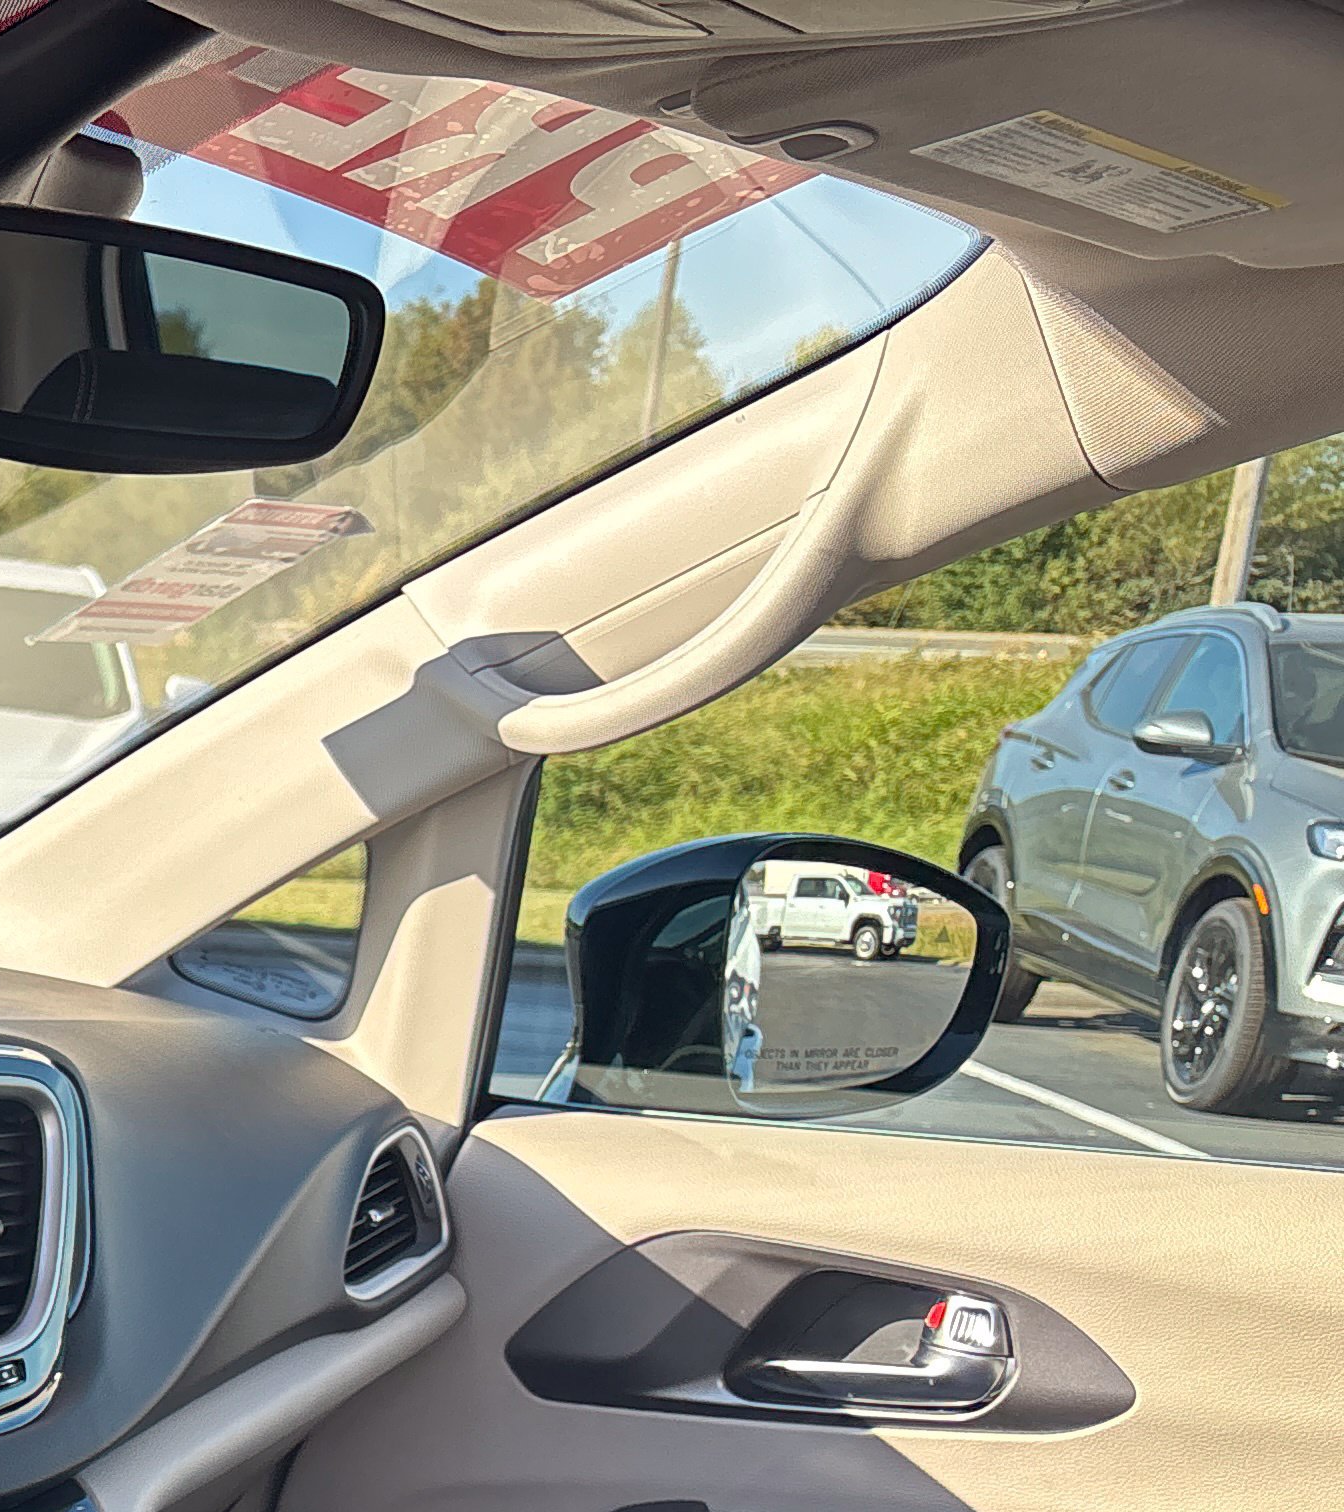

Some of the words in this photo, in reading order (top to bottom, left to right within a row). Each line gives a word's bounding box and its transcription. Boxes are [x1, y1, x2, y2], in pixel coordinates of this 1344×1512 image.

[790, 1047, 799, 1059] IN
[804, 1047, 840, 1059] MIRROR
[843, 1047, 861, 1059] ARE
[865, 1046, 900, 1058] CLOSER
[776, 1060, 801, 1072] THAN
[806, 1060, 829, 1071] THEY
[832, 1060, 871, 1071] APPEAR
